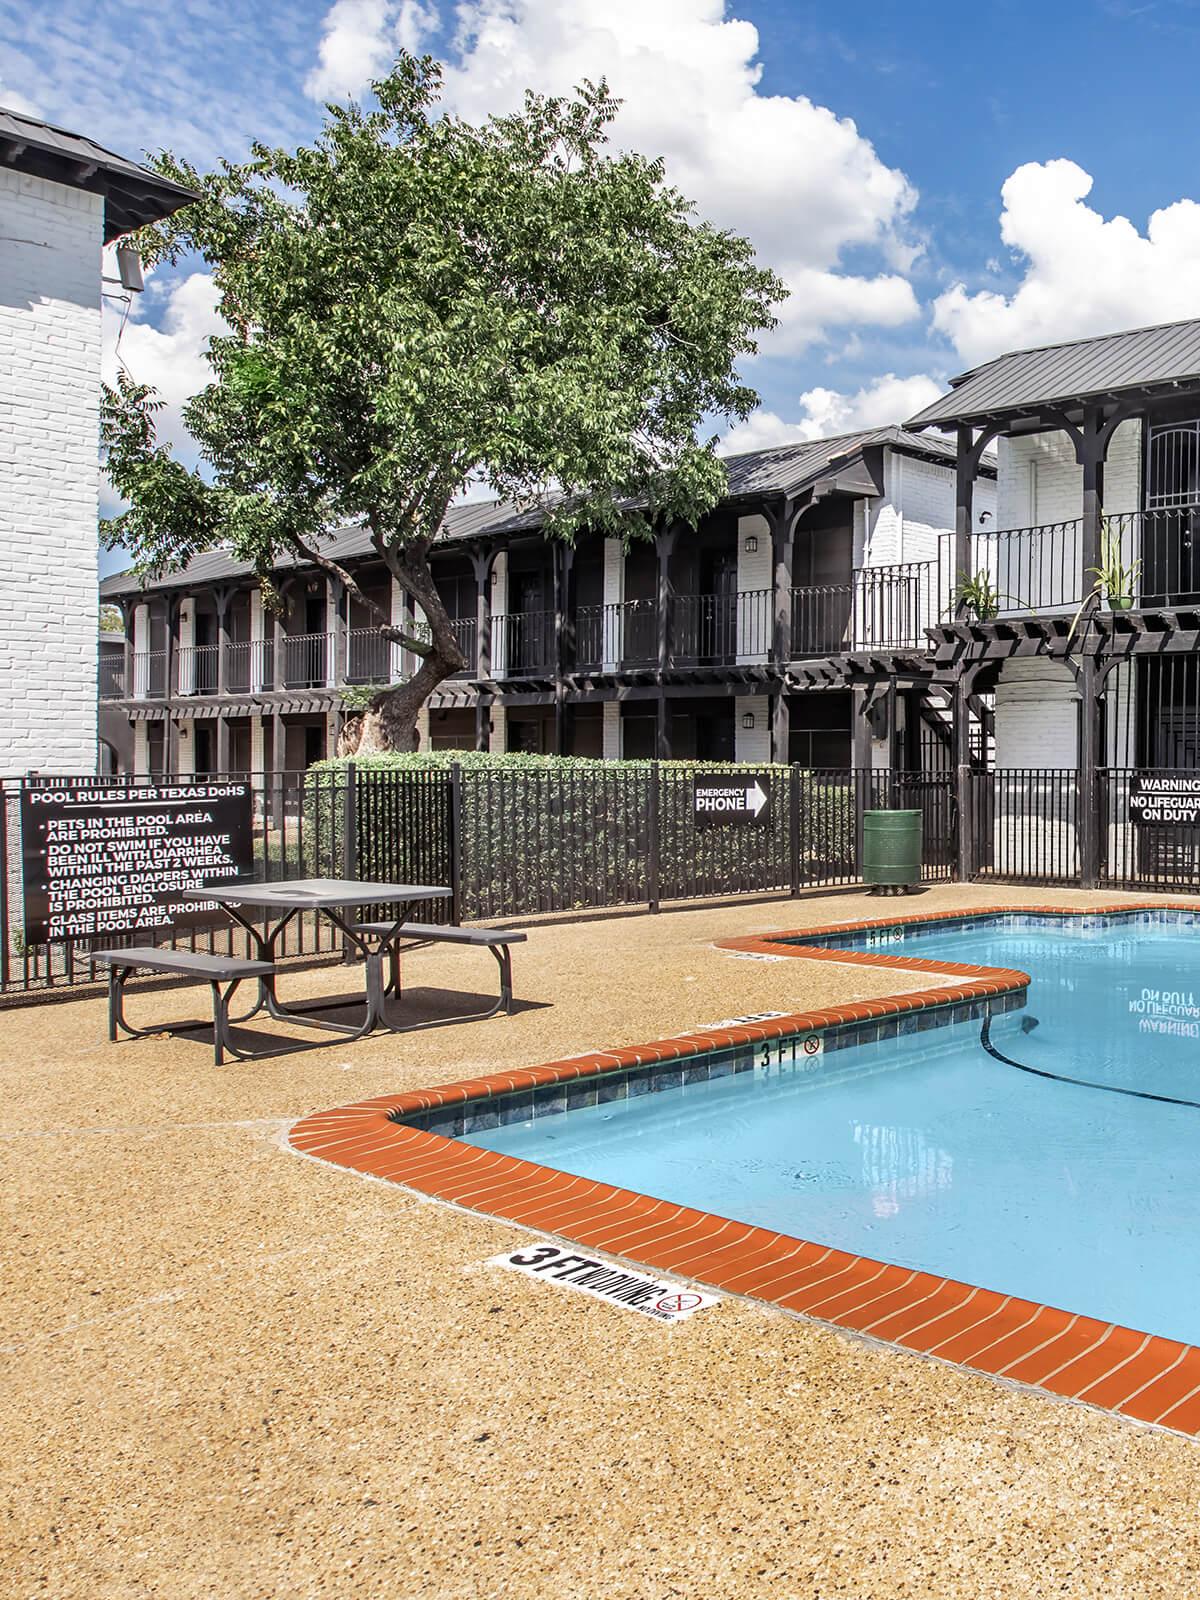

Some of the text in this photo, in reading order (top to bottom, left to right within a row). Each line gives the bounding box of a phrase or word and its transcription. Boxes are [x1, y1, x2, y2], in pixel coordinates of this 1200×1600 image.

[696, 788, 744, 797] EMERGENCY
[1140, 779, 1200, 791] WARNING
[30, 786, 245, 804] POOL RULES PER TEXAS DoHS
[696, 797, 745, 811] PHONE
[1130, 796, 1147, 807] NO
[48, 813, 213, 831] PETS IN THE POOL AREA
[1142, 809, 1198, 822] ON DUTY
[46, 825, 169, 842] ARE PROHIBITED.
[48, 834, 231, 856] DO NOT SWIM IF YOU HAVE
[48, 845, 223, 866] BEEN ILL WITH DIARRHEA
[48, 854, 234, 877] WITHIN THE PAST 2 WEEKS.
[49, 866, 239, 890] CHANGING DIAPERS WITHIN
[48, 879, 204, 901] THE POOL ENCLOSURE
[48, 893, 156, 912] IS PROHIBITED.
[50, 912, 95, 926] GLASS
[97, 908, 138, 921] ITEMS
[139, 905, 167, 917] ARE
[49, 915, 175, 937] IN THE POOL AREA.
[880, 929, 892, 943] FT
[761, 1037, 800, 1067] 3 FT
[509, 1247, 561, 1266] 3
[568, 1267, 617, 1290] NO
[597, 1273, 668, 1307] DIVING
